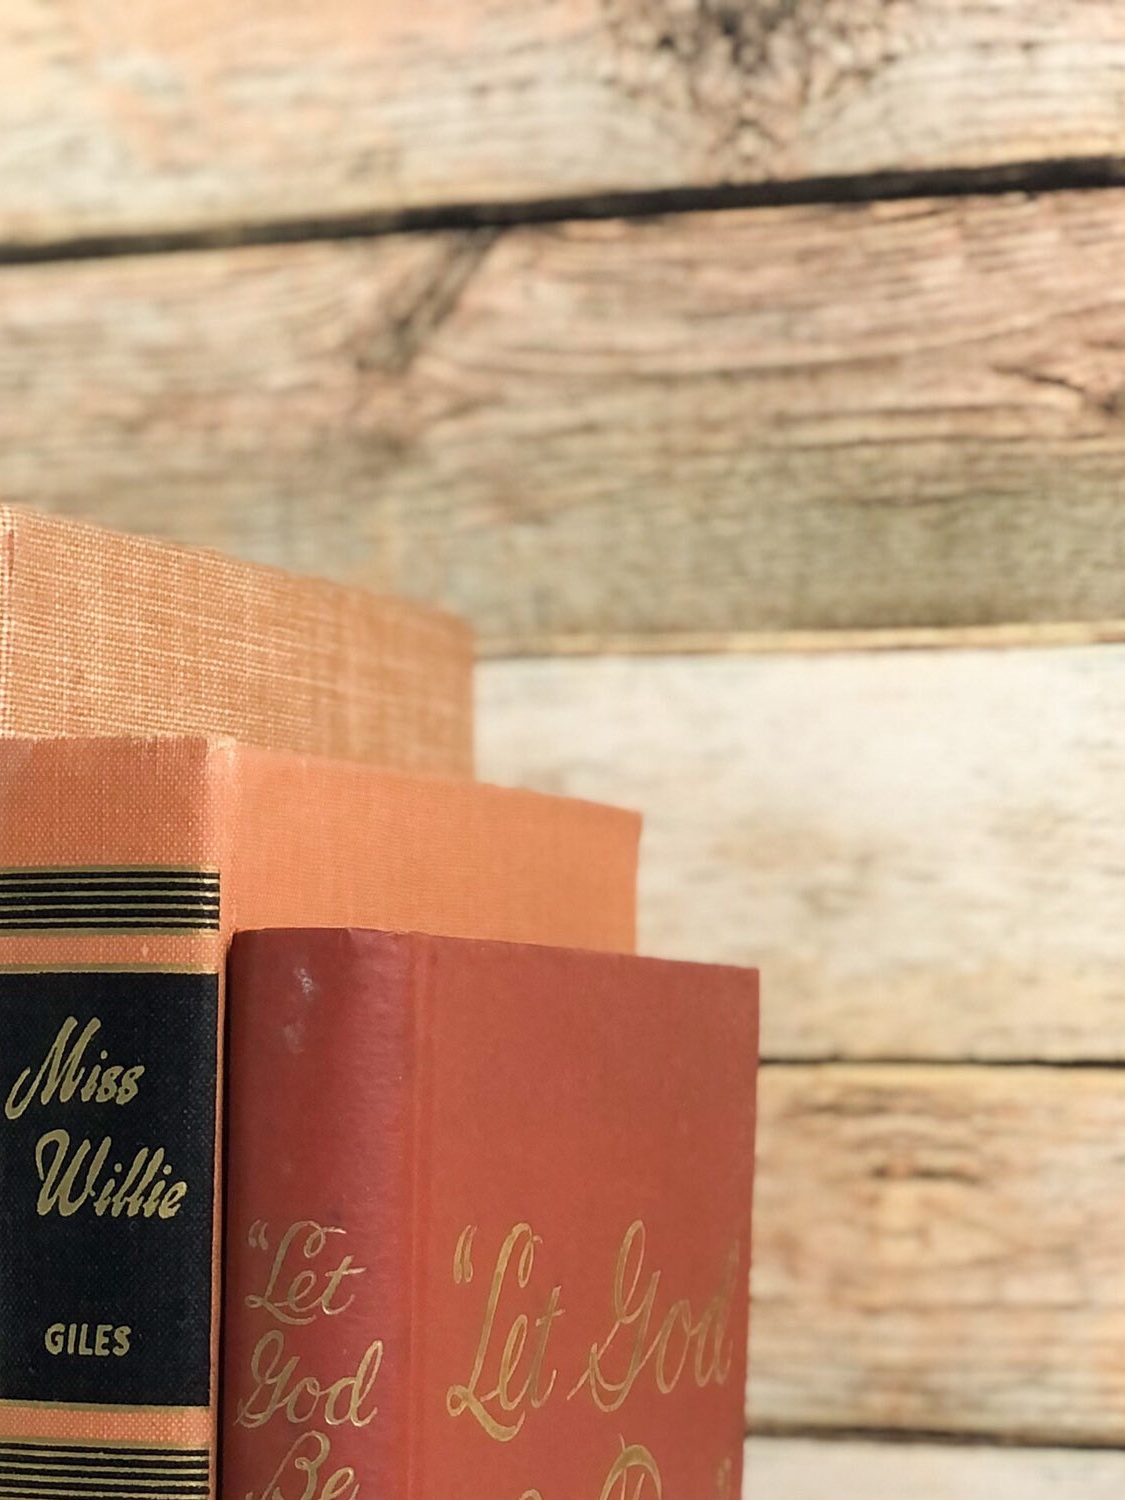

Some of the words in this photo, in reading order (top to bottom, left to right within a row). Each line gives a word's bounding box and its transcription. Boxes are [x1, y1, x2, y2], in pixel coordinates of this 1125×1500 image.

[4, 1016, 146, 1120] Miss
[34, 1128, 187, 1219] Willie
[44, 1322, 132, 1357] GILES
[233, 1329, 384, 1428] God
